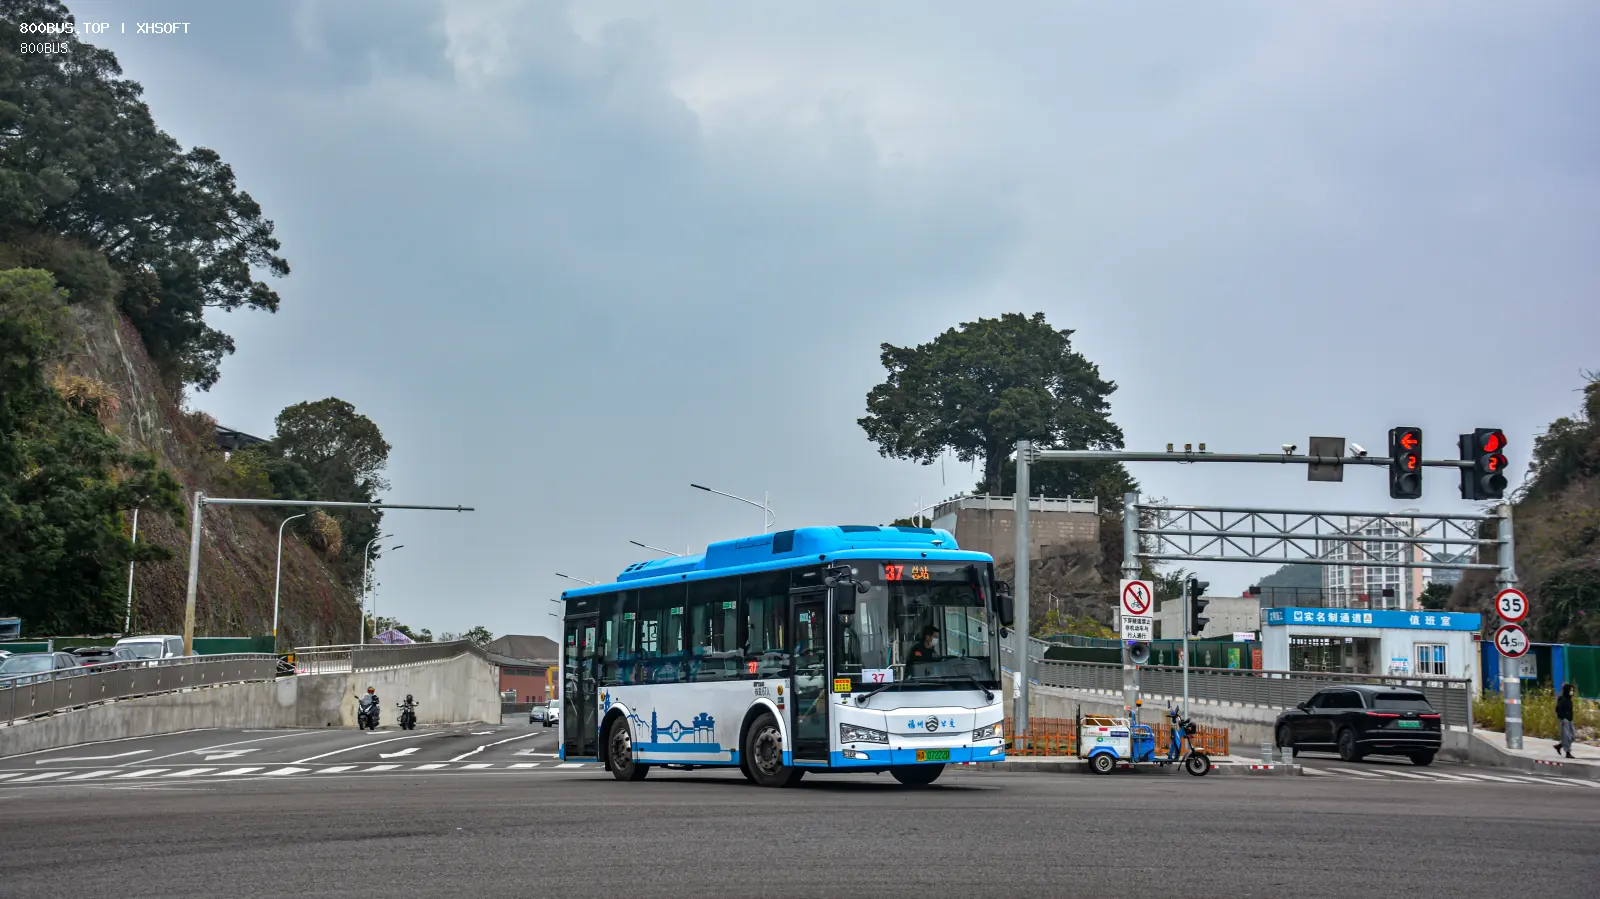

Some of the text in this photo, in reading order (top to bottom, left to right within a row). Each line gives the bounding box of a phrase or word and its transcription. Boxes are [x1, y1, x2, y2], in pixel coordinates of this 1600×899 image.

[1407, 456, 1416, 469] 2
[1488, 457, 1498, 470] 2
[884, 564, 904, 581] 37
[1502, 598, 1522, 612] 35
[1304, 611, 1451, 626] 实名制通道 值班室
[748, 661, 758, 674] 37
[871, 673, 885, 683] 37
